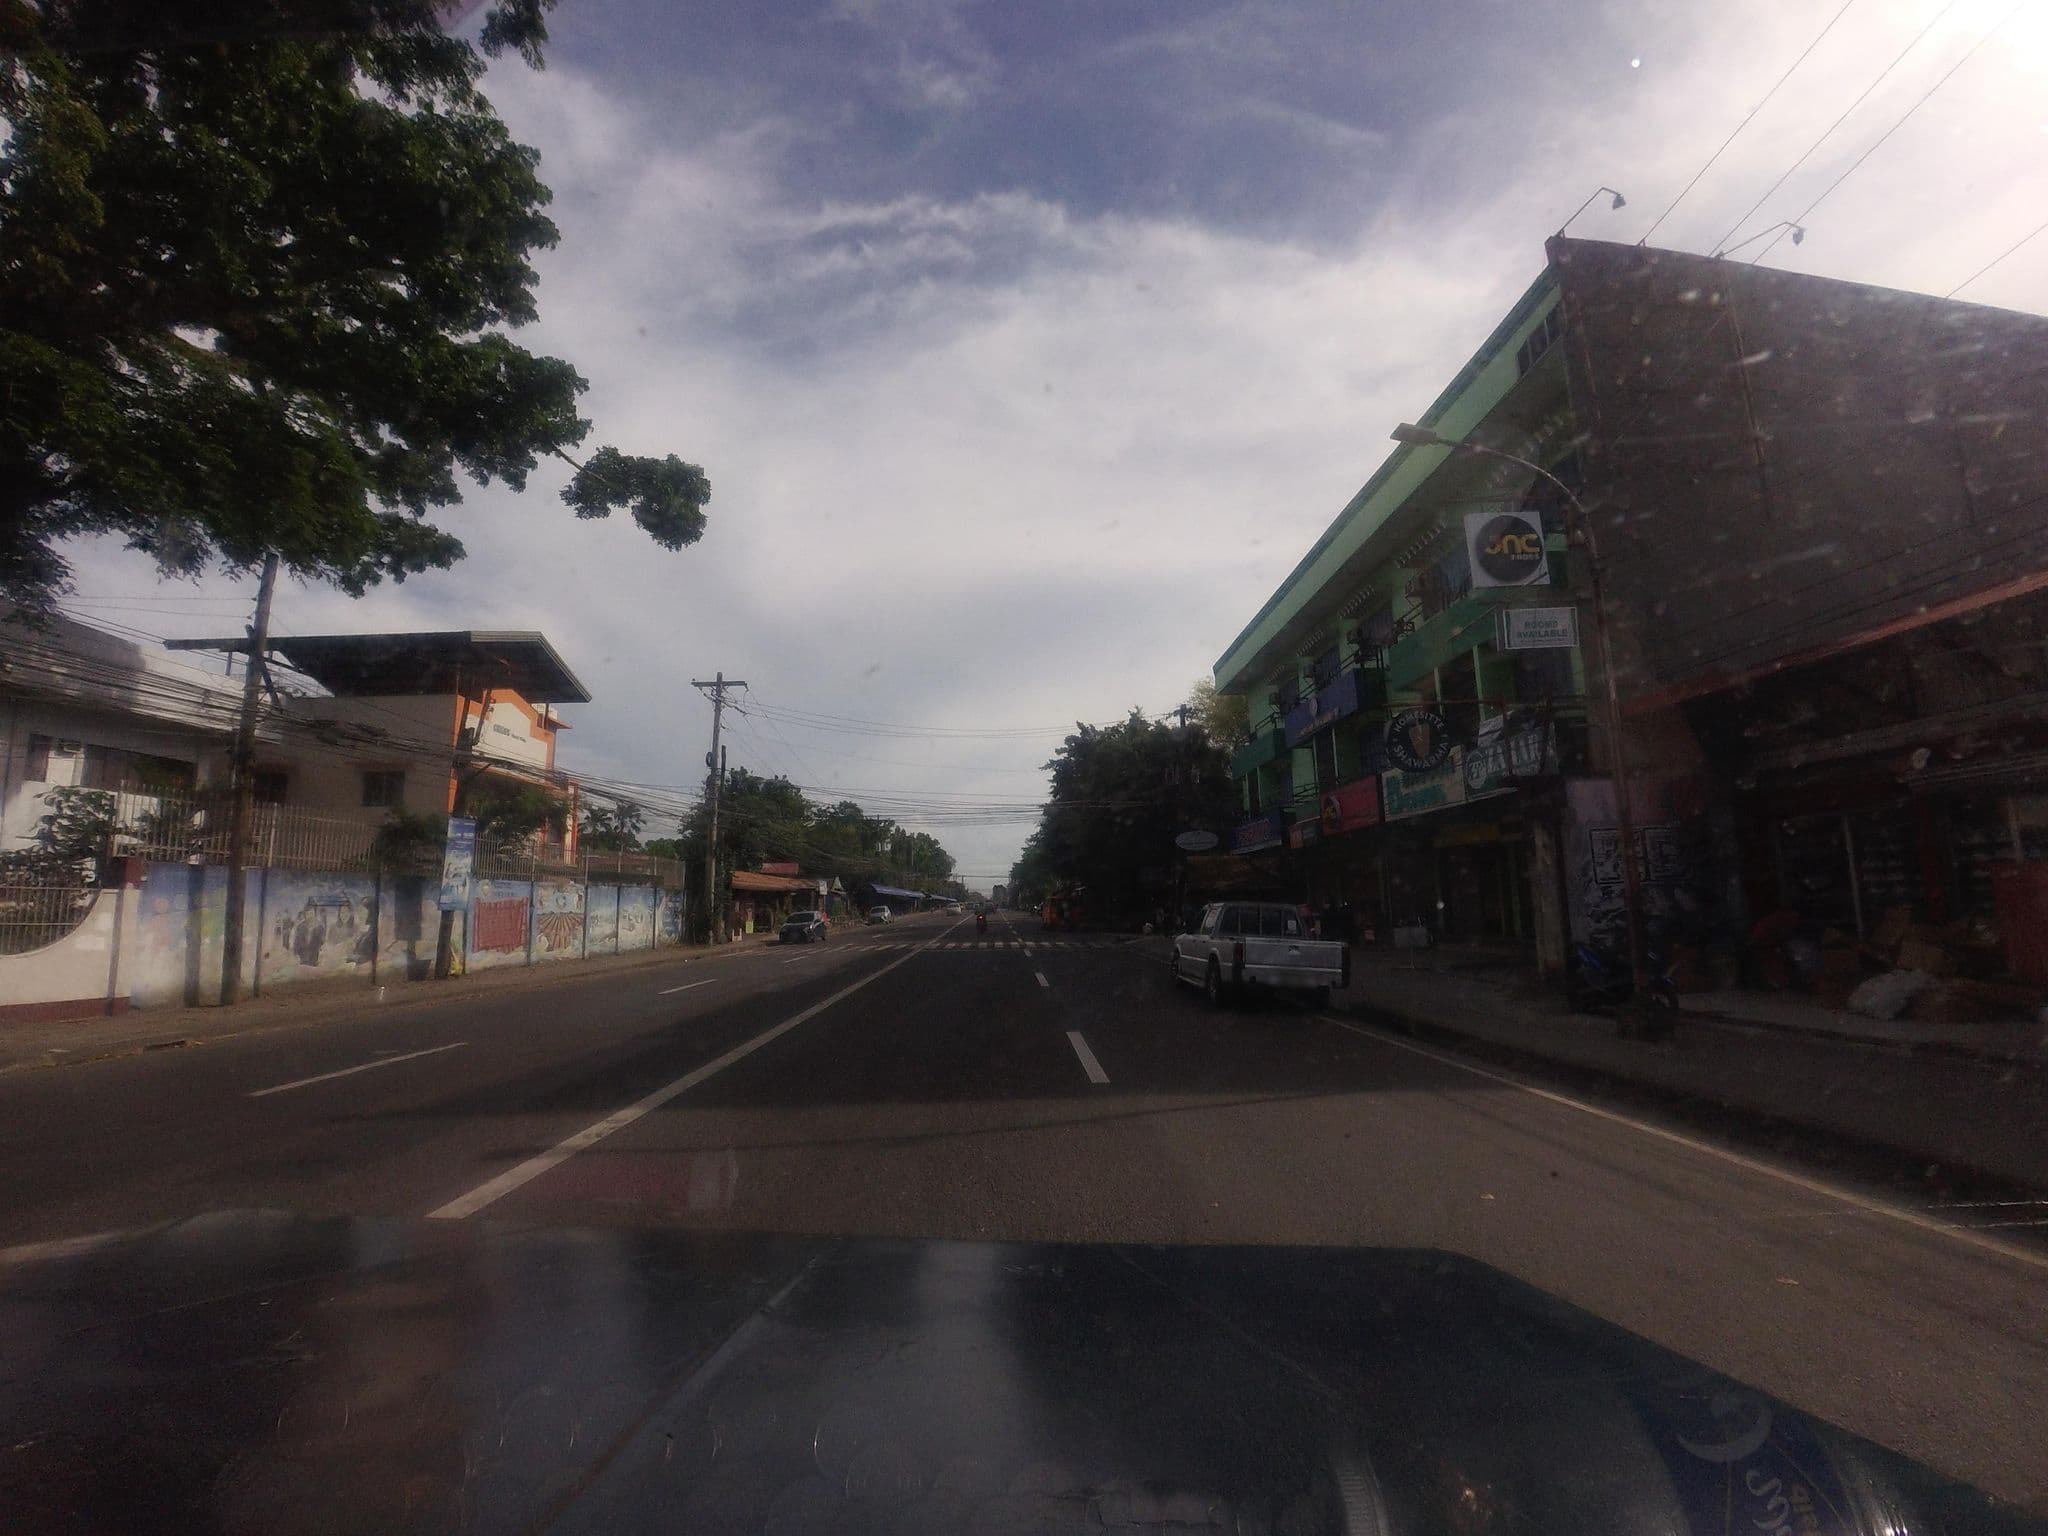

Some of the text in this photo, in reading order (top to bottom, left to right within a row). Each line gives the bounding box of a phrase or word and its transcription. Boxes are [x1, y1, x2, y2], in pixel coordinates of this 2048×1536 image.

[1524, 620, 1559, 630] ROOMS
[1519, 629, 1568, 639] AVAILABLE
[1393, 742, 1449, 768] SHAWARMA
